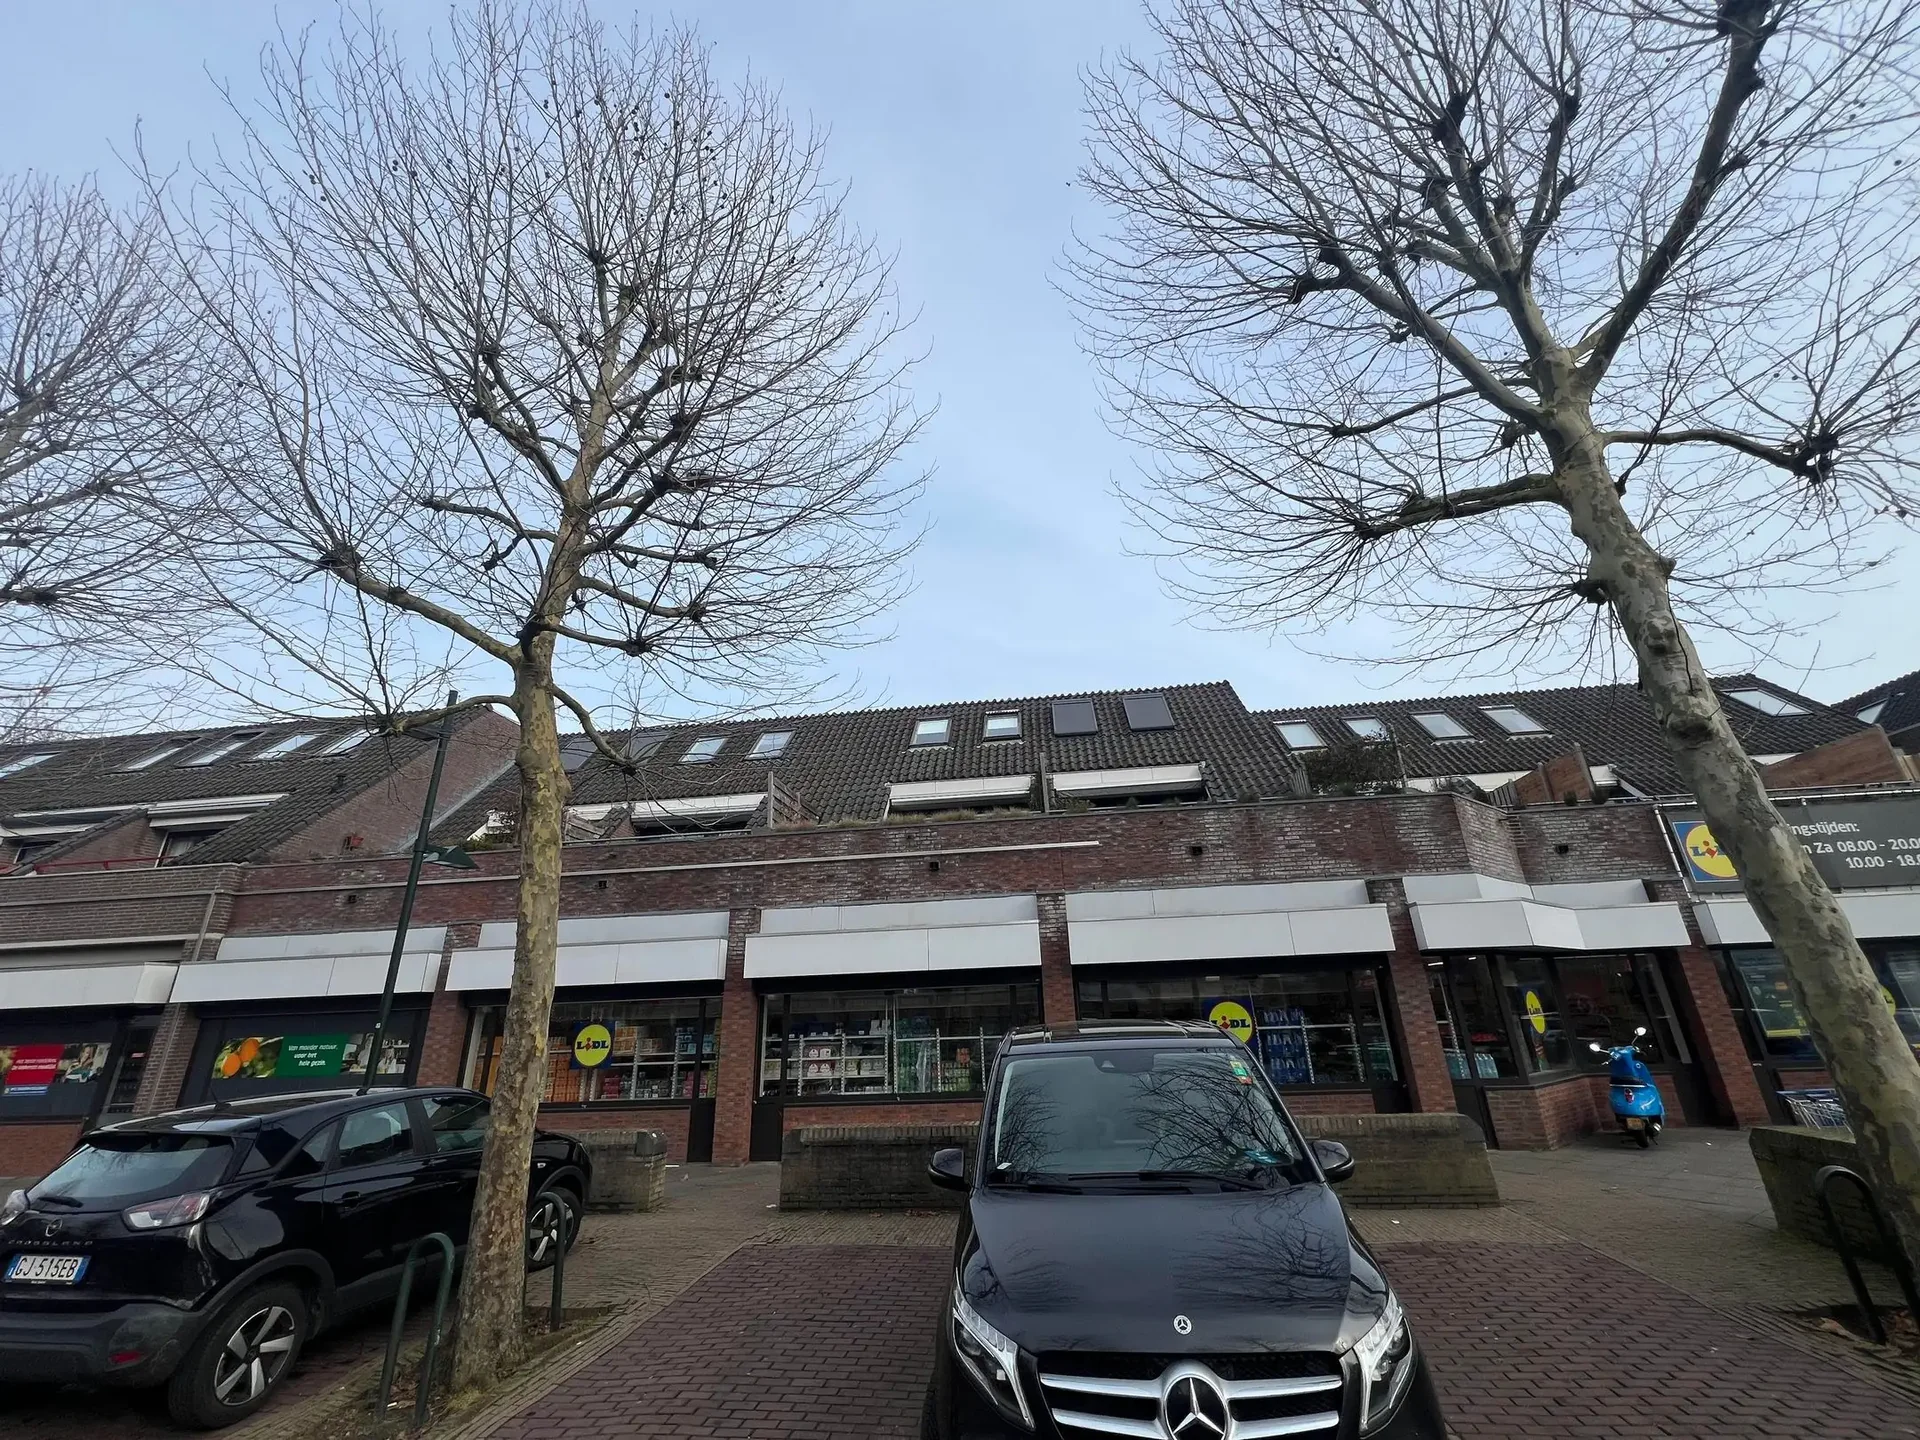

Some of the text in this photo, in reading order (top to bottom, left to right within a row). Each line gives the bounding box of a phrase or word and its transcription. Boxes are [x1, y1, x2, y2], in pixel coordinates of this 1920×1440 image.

[1787, 822, 1860, 836] ngstijden:
[1813, 842, 1834, 854] Za
[1837, 840, 1877, 852] 08.00
[1888, 837, 1920, 850] 20.0
[1845, 856, 1885, 869] 10.00
